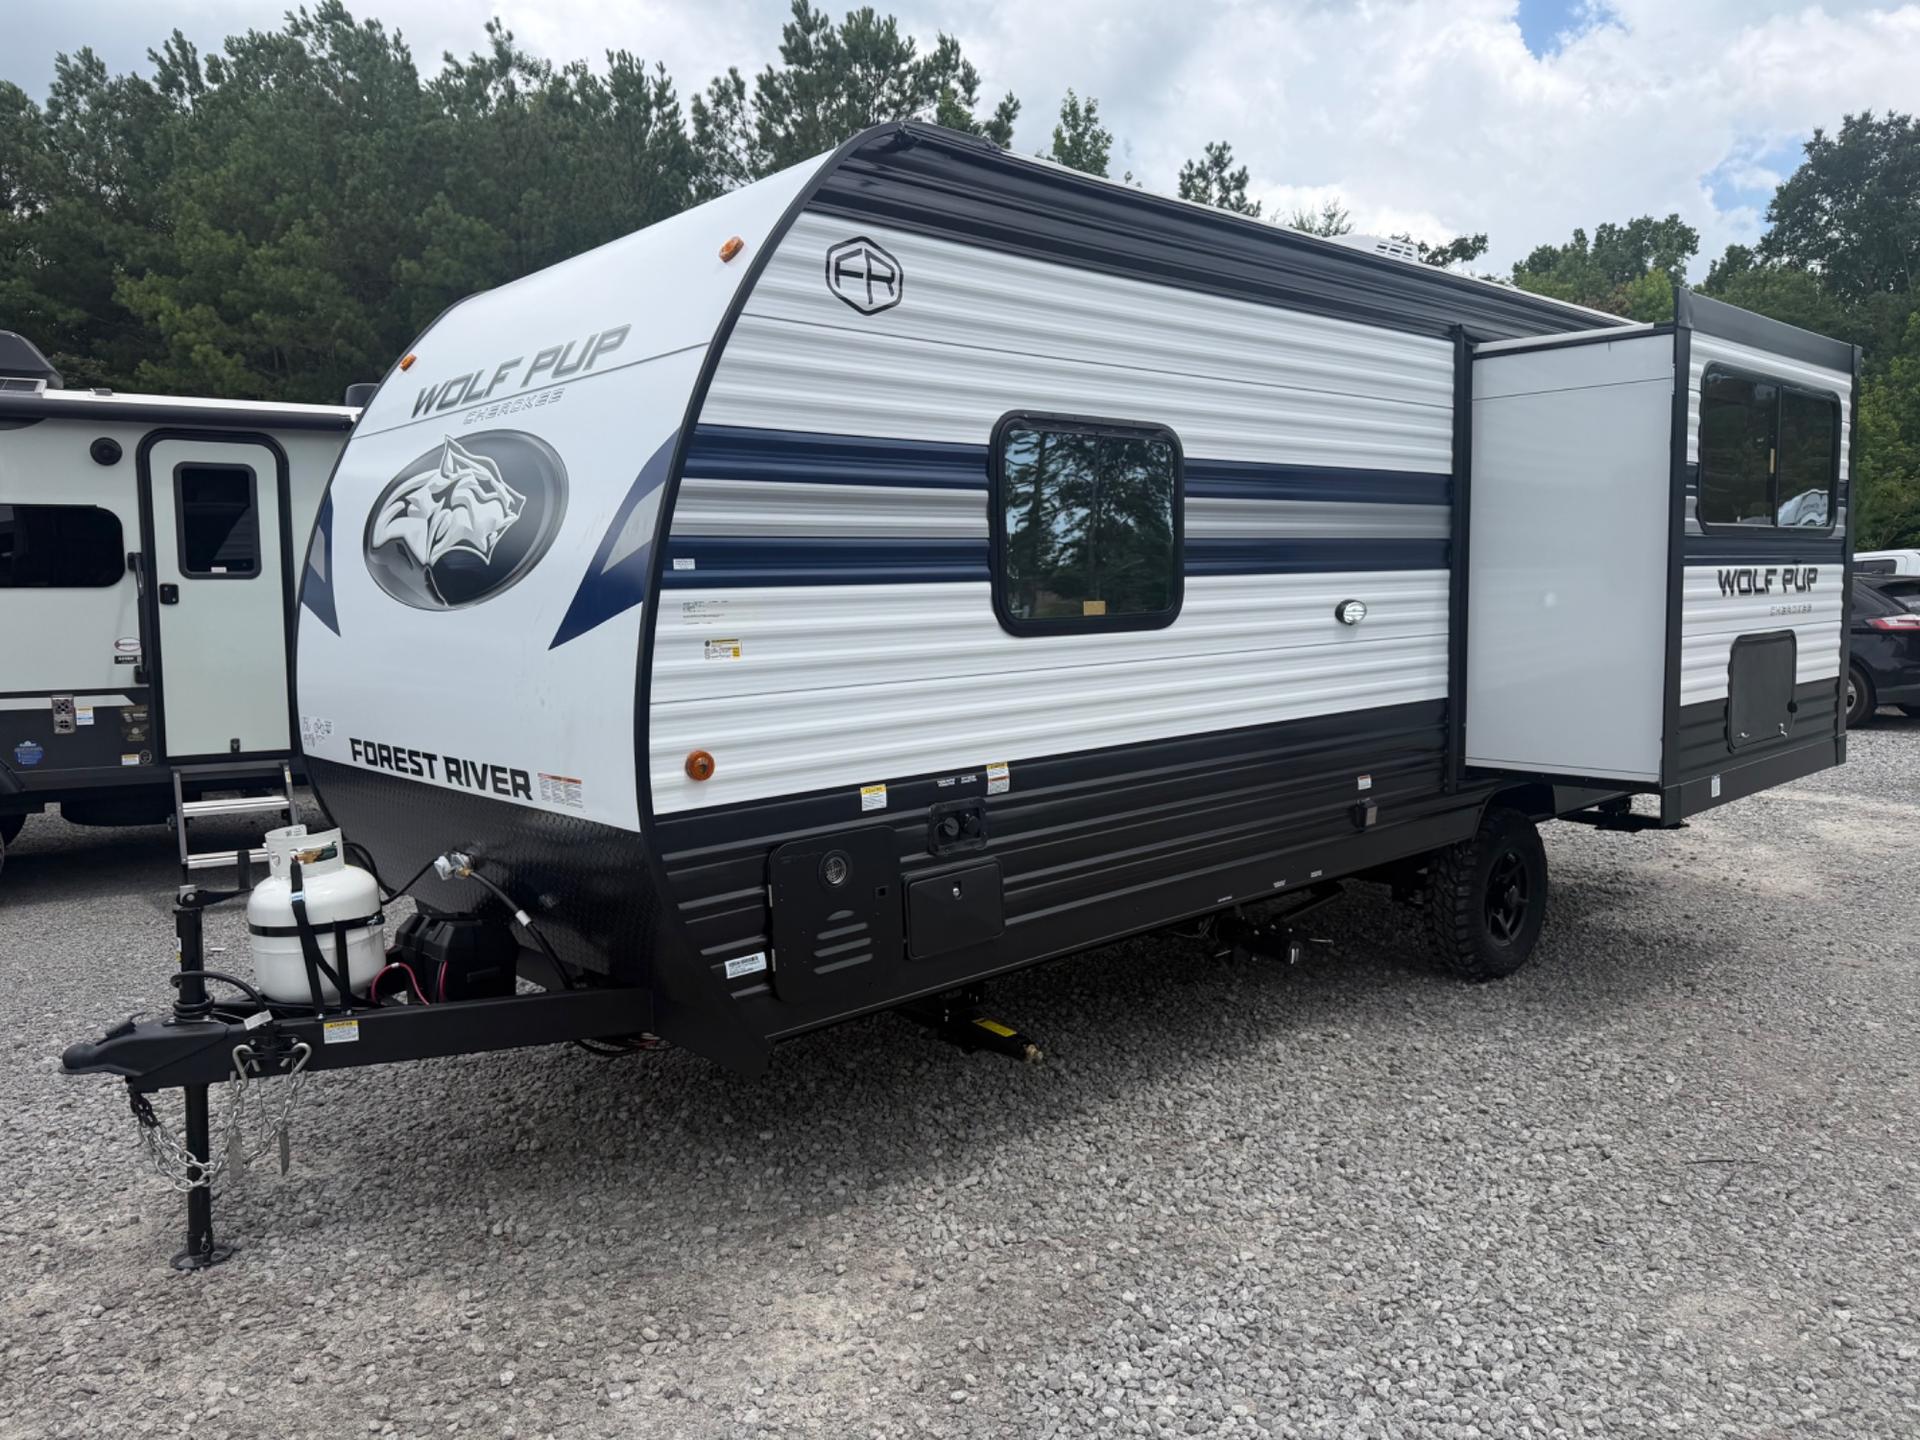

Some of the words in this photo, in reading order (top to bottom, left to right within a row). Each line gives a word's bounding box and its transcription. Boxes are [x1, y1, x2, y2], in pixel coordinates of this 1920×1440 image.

[411, 356, 525, 419] WOLF
[520, 323, 633, 388] PUP
[463, 387, 566, 425] CHEROKEE
[1718, 568, 1777, 597] WOLF
[1782, 567, 1818, 593] PUP
[349, 737, 438, 780] FOREST
[442, 755, 534, 801] RIVER
